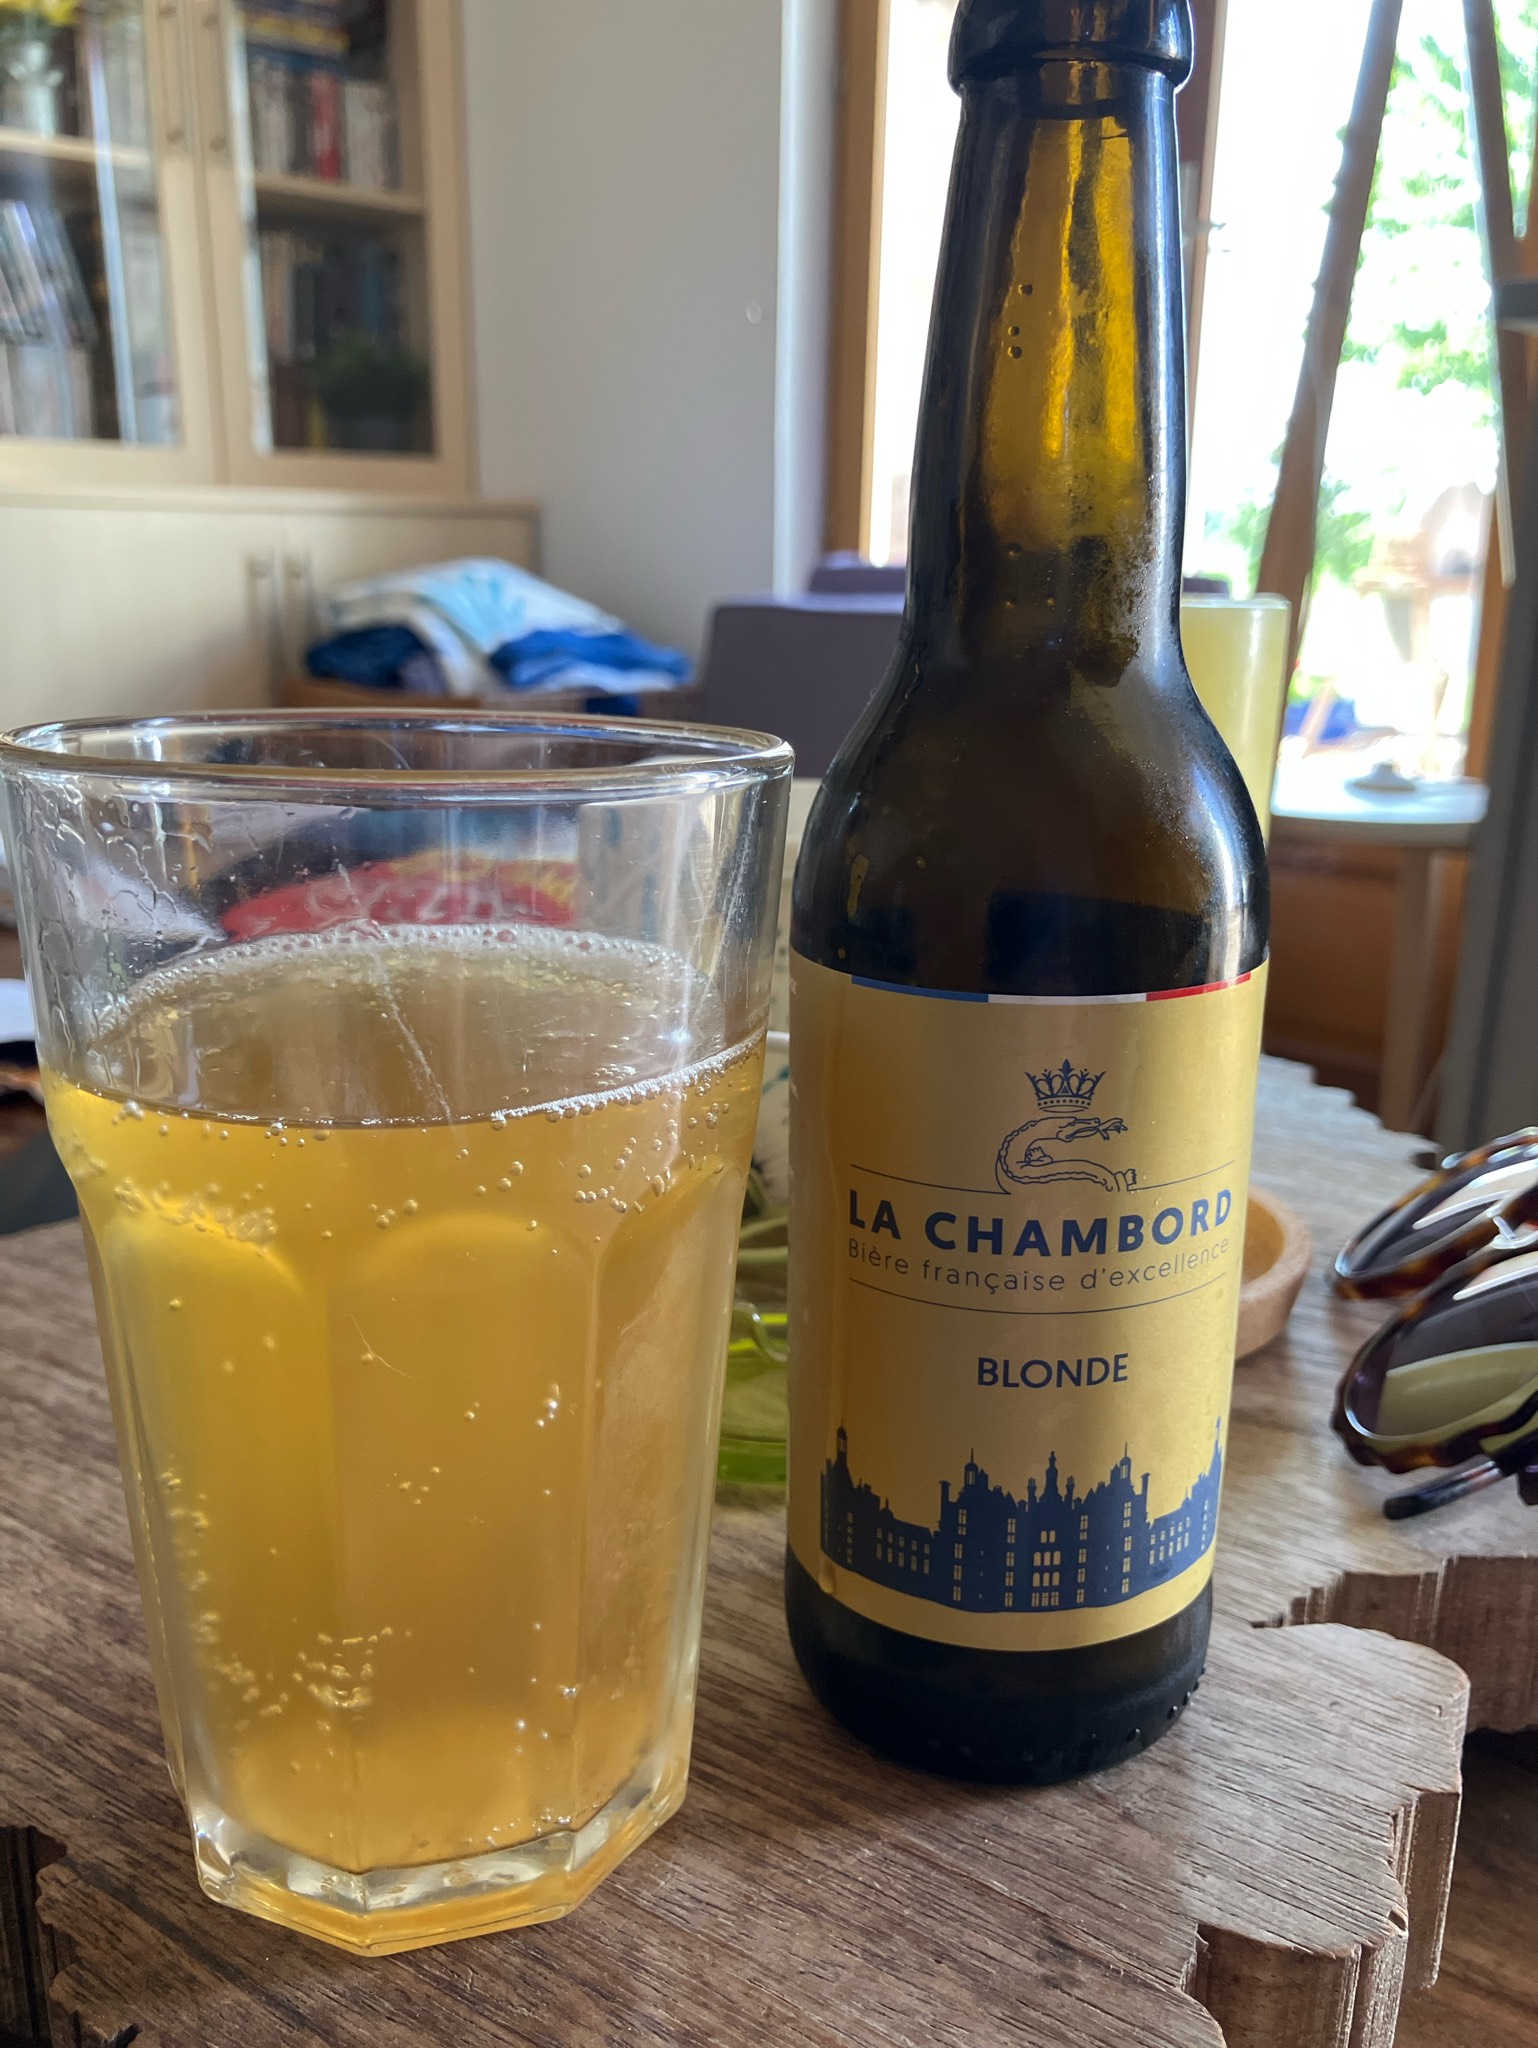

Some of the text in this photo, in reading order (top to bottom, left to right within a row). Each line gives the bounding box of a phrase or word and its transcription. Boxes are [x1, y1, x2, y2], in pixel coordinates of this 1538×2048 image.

[849, 1188, 1233, 1258] LA CHAMBORD
[848, 1236, 1230, 1294] Bière française d'excellence
[977, 1353, 1129, 1389] BLONDE
